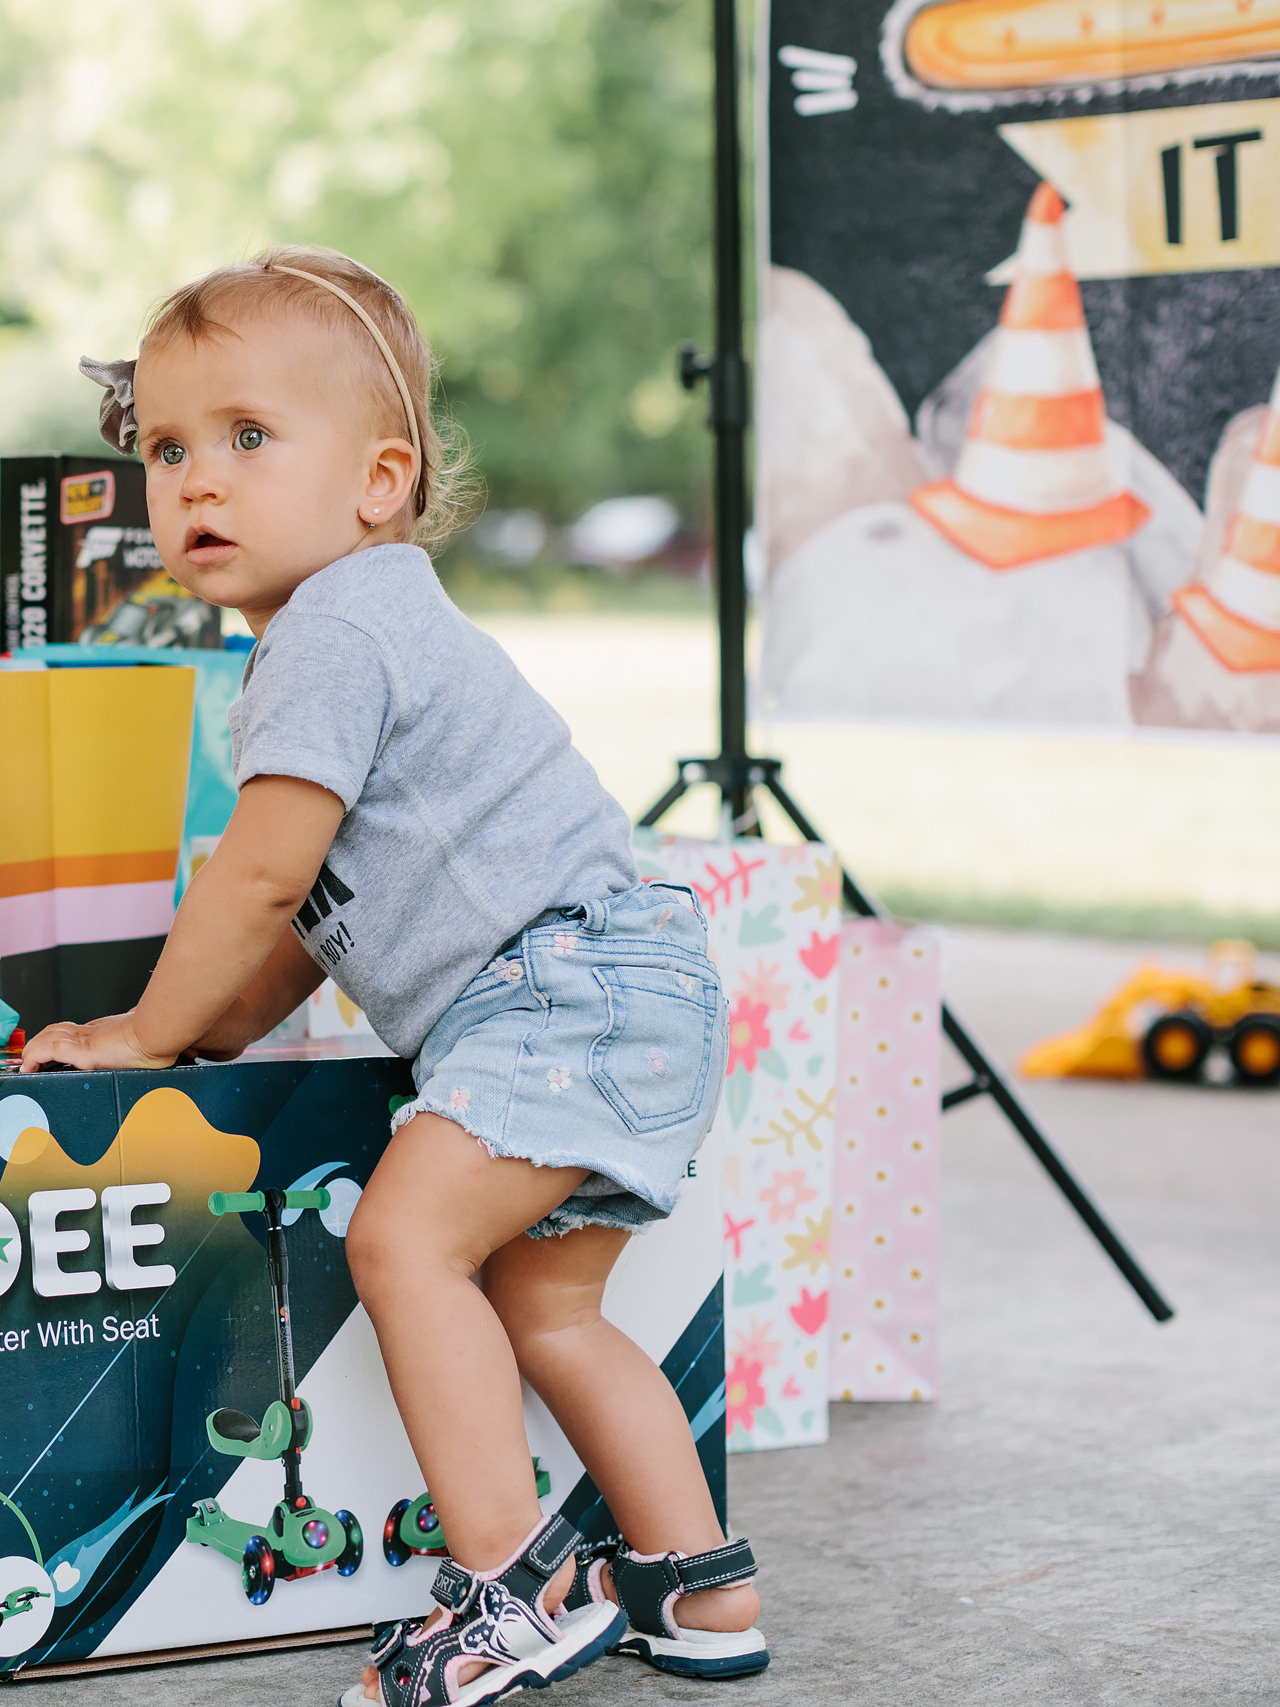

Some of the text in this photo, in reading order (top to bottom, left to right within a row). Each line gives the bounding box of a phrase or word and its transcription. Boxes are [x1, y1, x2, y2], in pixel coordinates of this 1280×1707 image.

[1160, 130, 1263, 246] IT
[320, 921, 355, 966] BOY!
[37, 1318, 94, 1348] With
[102, 1313, 161, 1341] Seat
[436, 1572, 457, 1593] ORT
